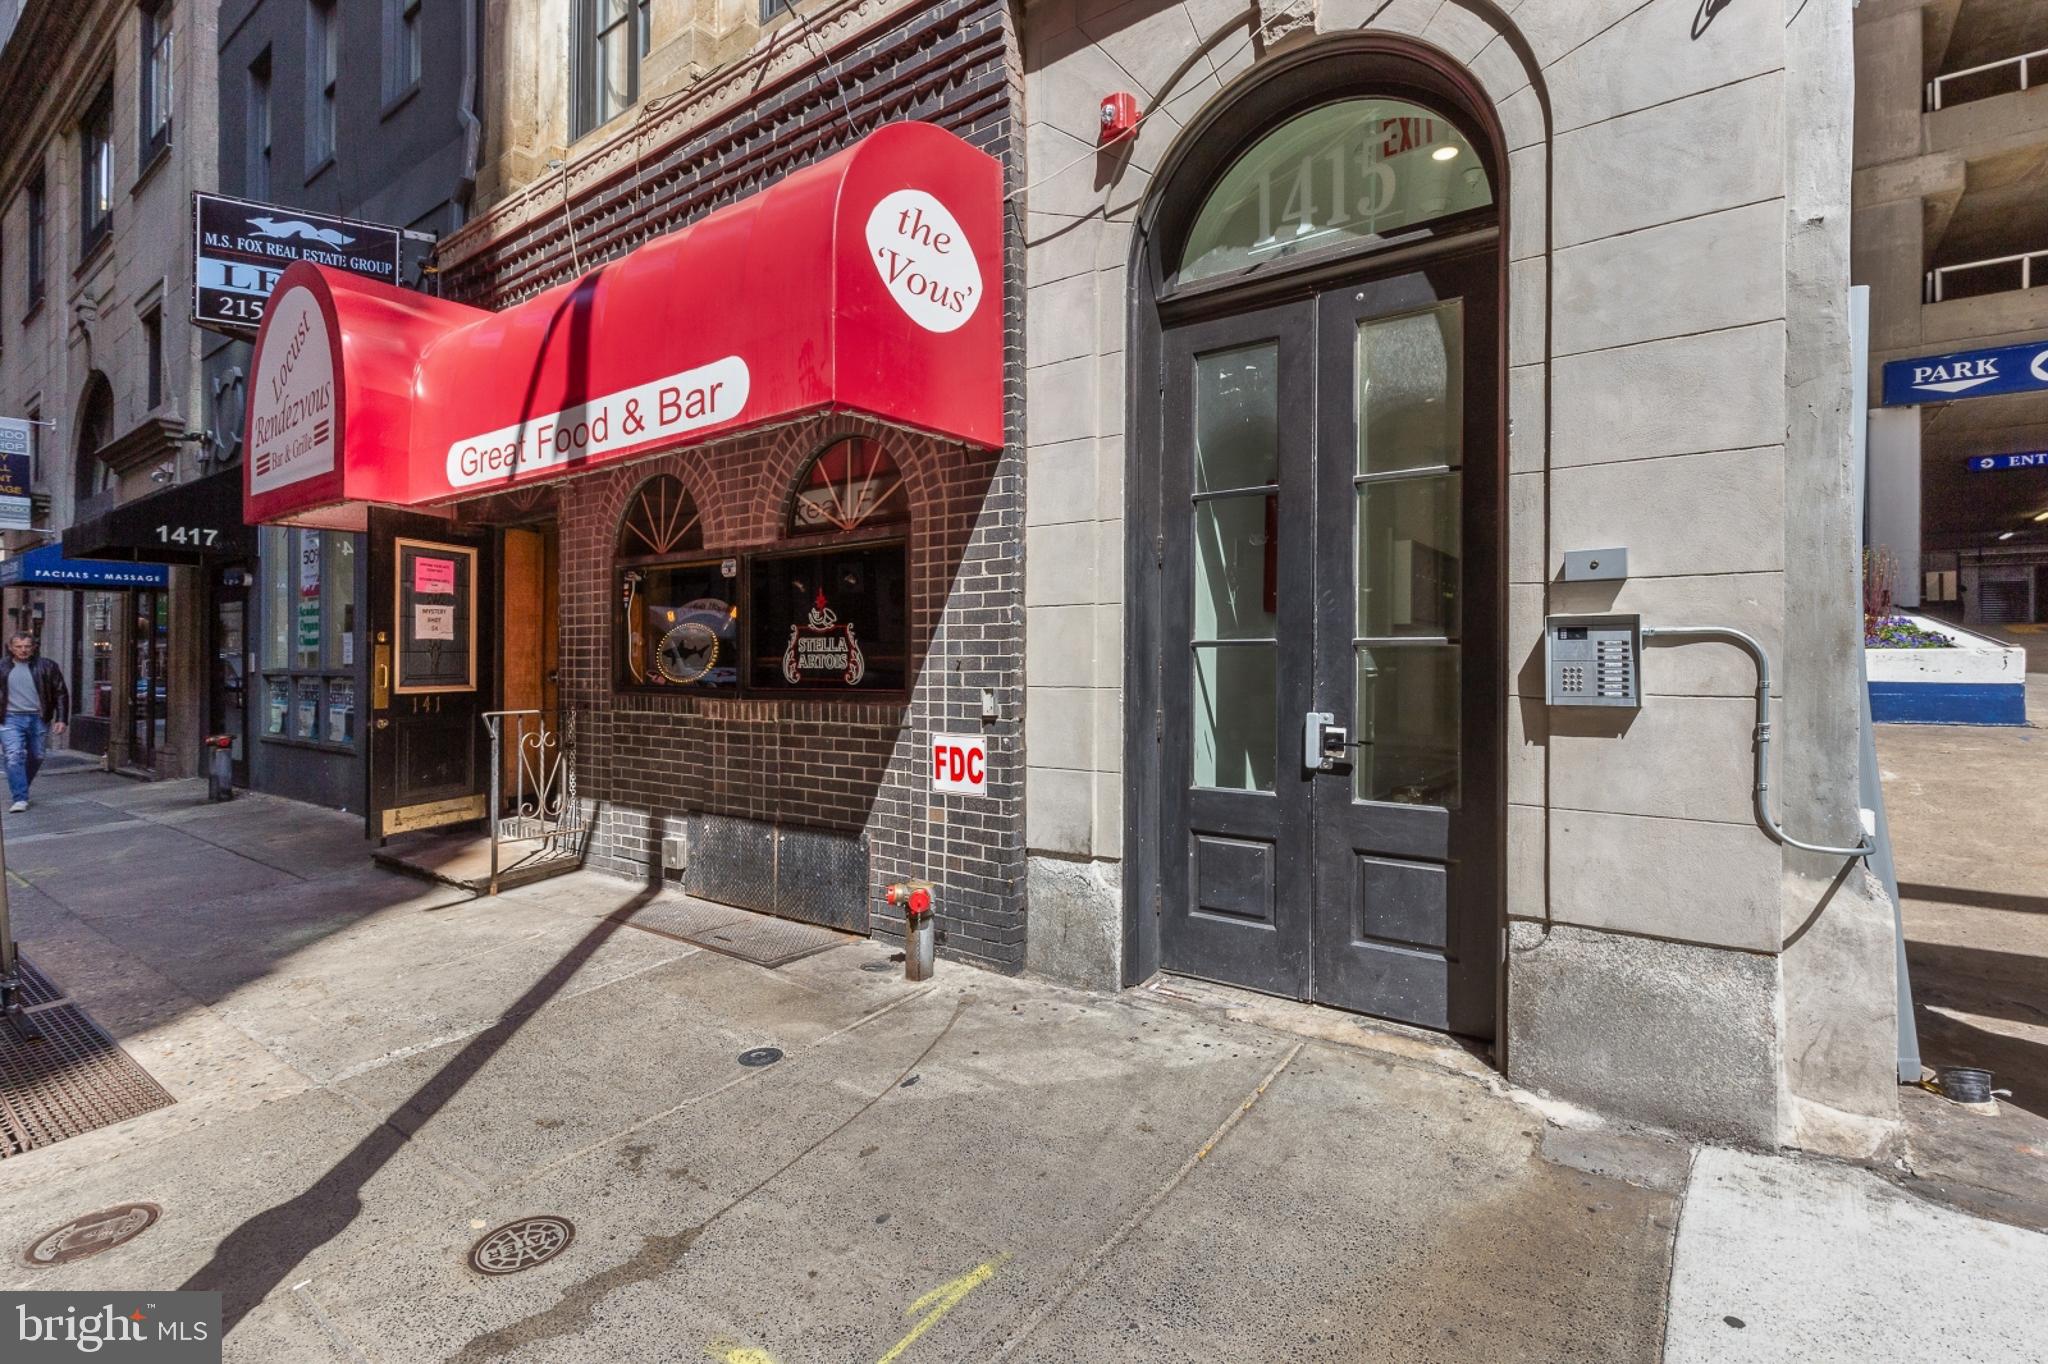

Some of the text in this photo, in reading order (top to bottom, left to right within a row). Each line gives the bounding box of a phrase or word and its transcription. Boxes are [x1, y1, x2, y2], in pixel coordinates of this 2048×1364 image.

[1250, 127, 1397, 247] 1415
[898, 207, 951, 254] the
[205, 232, 393, 275] M.S. FOX REAL ESTATE GROUP
[219, 296, 264, 320] 215
[271, 310, 311, 404] Locust
[1912, 357, 1999, 384] PARK
[255, 380, 331, 448] Rendezvous
[460, 381, 724, 477] Great Food & Bar
[272, 433, 312, 470] Bar & Grille
[2008, 453, 2048, 467] ENT
[156, 525, 218, 546] 1417
[35, 570, 160, 582] FACIALS MASSAGE
[797, 653, 849, 670] ARTOIS
[798, 637, 849, 653] STELLA
[935, 745, 984, 785] FDC
